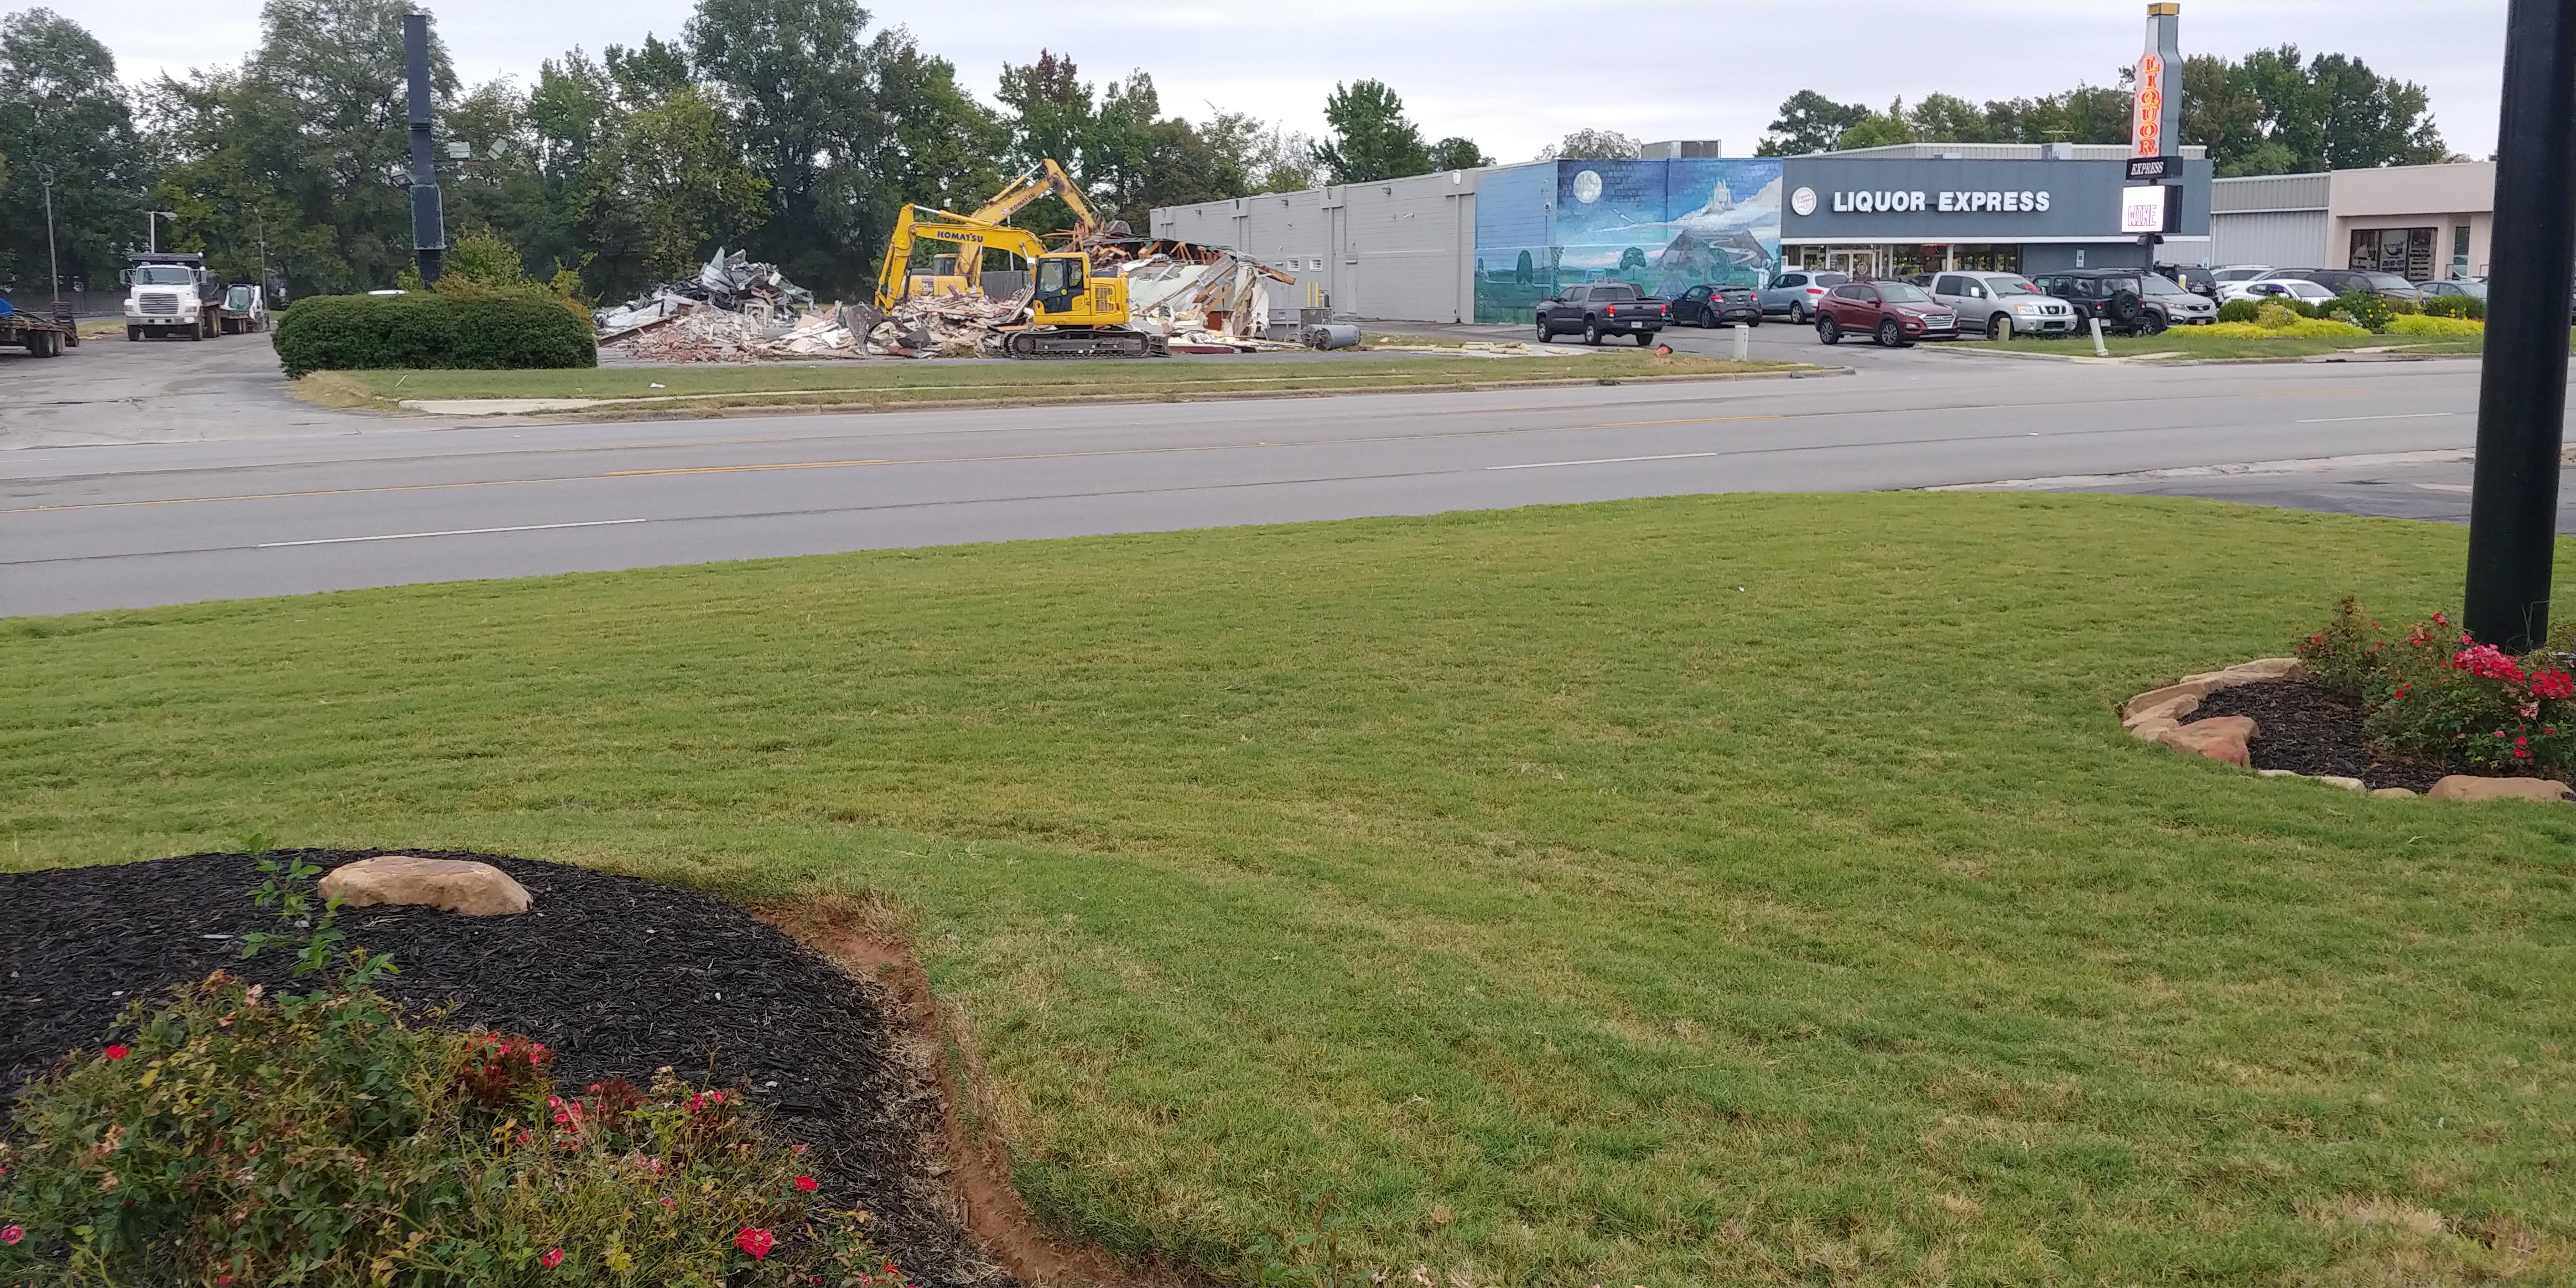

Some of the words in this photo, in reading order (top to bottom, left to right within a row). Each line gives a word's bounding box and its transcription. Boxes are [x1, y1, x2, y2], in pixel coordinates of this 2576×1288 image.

[2138, 56, 2160, 155] LIQUOR
[2131, 162, 2163, 175] EXPRESS
[1009, 193, 1035, 212] KOMATSU
[1834, 191, 1925, 213] LIQUOR
[1938, 191, 2050, 212] EXPRESS
[2128, 205, 2157, 226] WINE
[937, 231, 983, 242] KOMATSU
